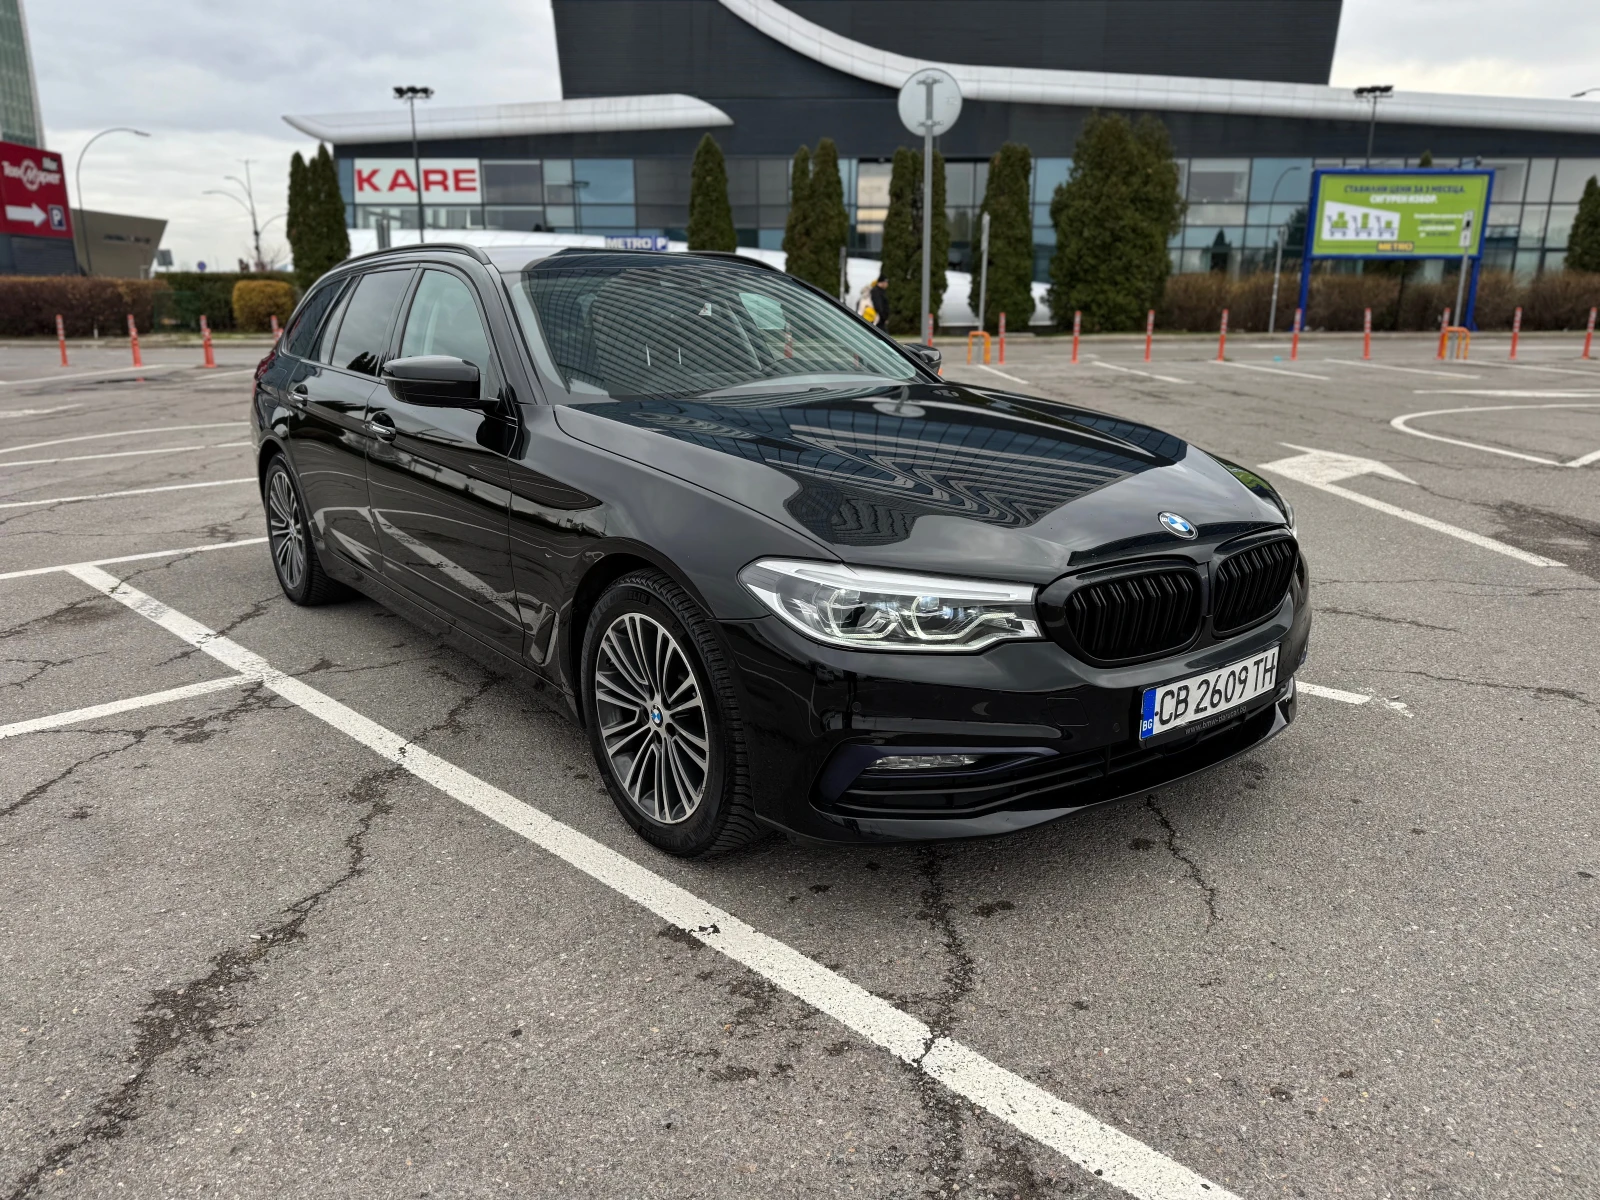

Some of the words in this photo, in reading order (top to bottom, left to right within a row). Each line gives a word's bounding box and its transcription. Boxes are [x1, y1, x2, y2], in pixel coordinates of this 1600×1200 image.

[355, 168, 477, 192] KARE
[52, 212, 61, 227] P
[606, 236, 652, 249] METRO
[1378, 243, 1413, 251] METRO
[1159, 684, 1190, 725] CB
[1193, 665, 1249, 714] 2609
[1253, 652, 1276, 692] TH
[1142, 718, 1153, 732] BG
